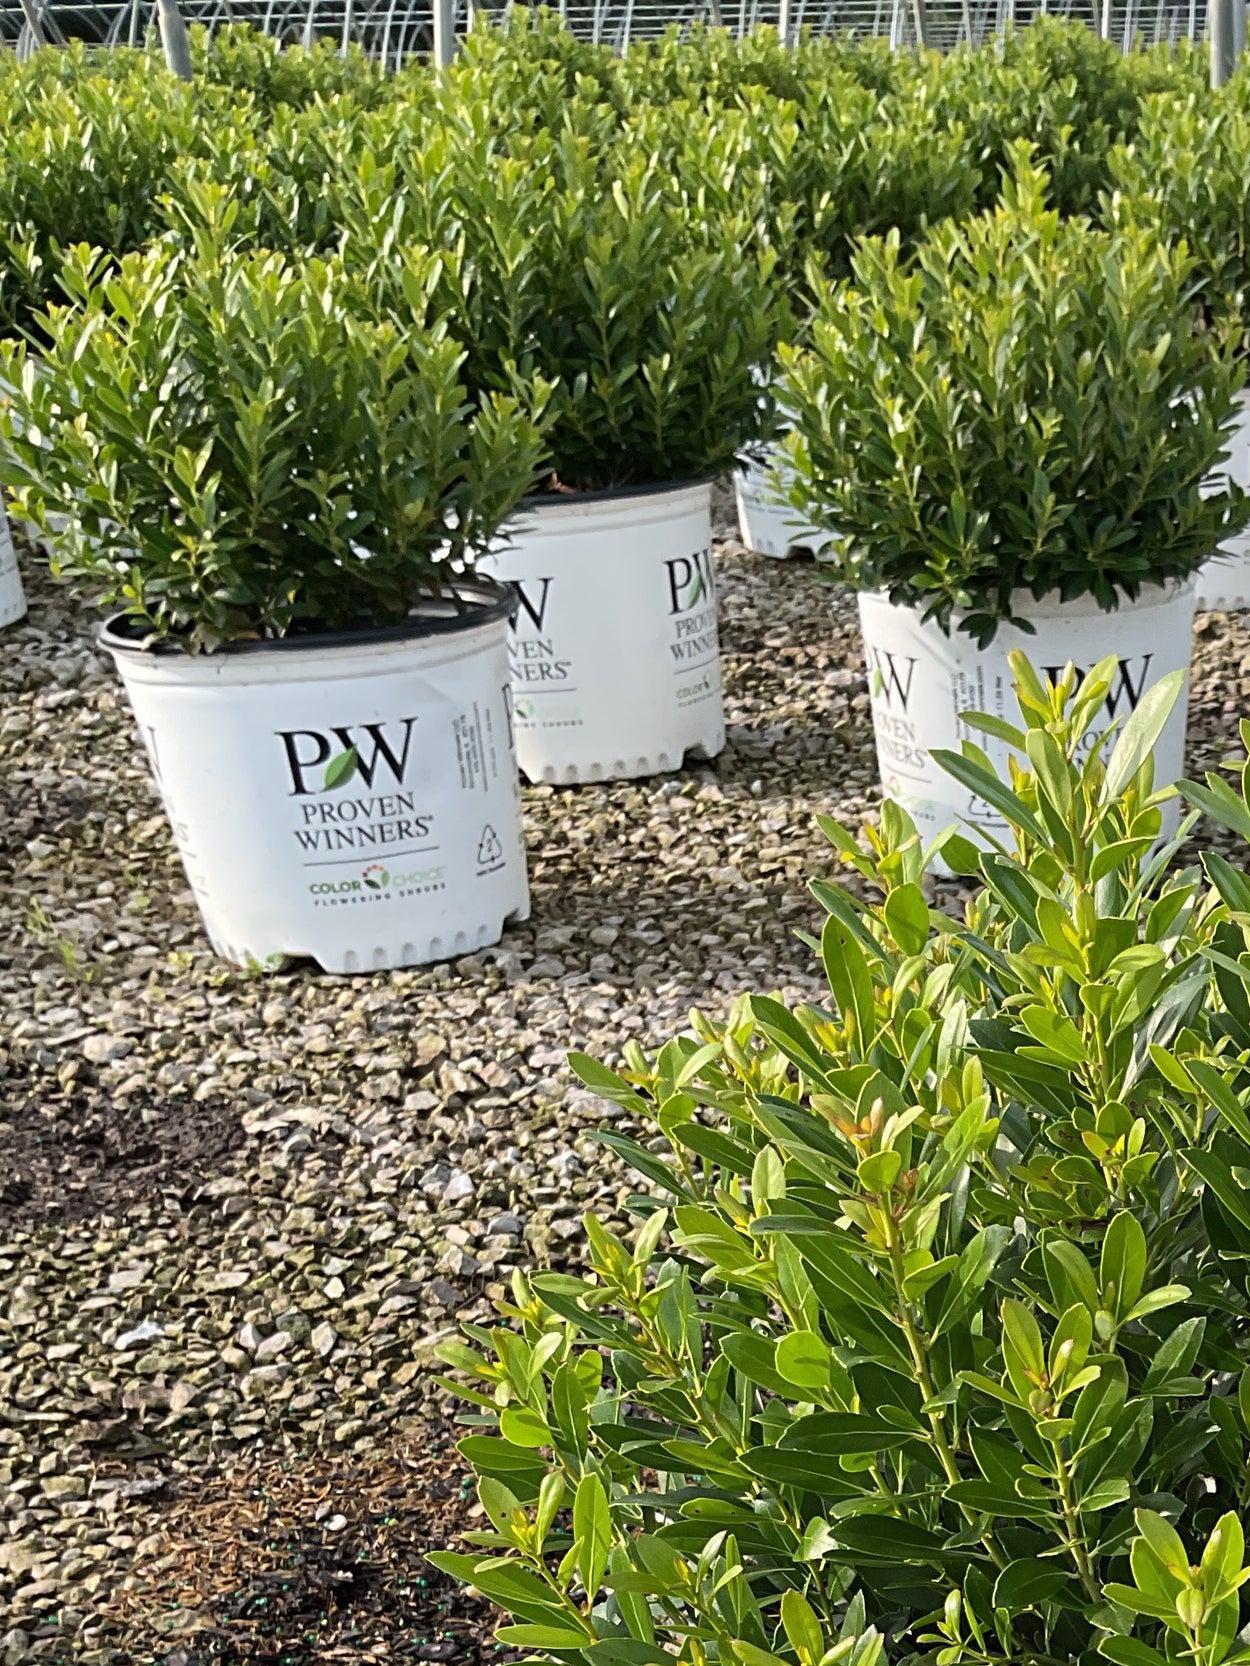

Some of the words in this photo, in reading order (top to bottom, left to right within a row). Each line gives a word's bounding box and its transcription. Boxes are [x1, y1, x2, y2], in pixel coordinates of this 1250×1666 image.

[506, 639, 555, 660] VEN
[274, 716, 418, 797] PW
[301, 791, 416, 825] PROVEN
[309, 880, 362, 895] COLOR
